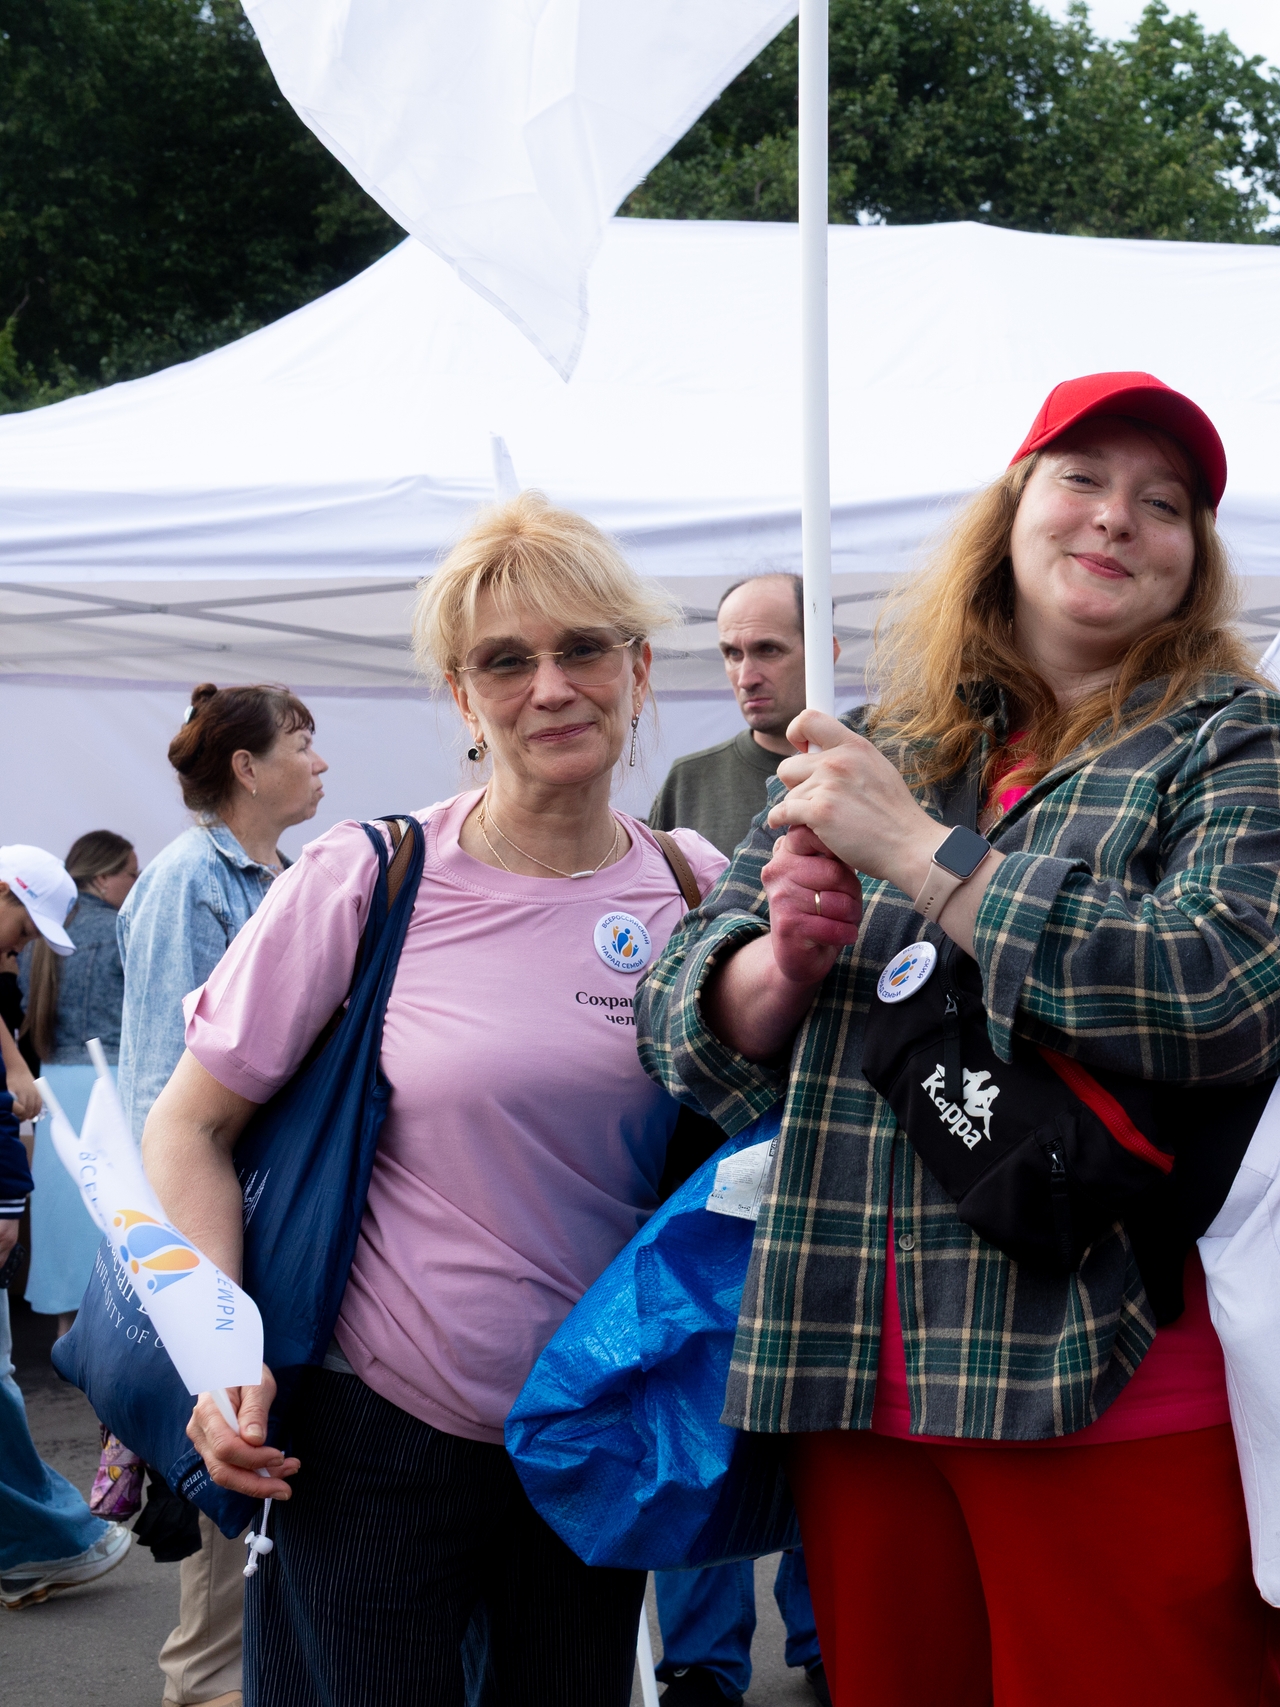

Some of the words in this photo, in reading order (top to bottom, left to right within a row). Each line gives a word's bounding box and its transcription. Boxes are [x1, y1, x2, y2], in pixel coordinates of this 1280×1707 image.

[601, 945, 620, 967] ПАРАД
[621, 958, 644, 969] СЕМЬИ
[604, 1013, 635, 1026] чел
[920, 1069, 982, 1151] Kappa
[126, 1324, 149, 1344] OF
